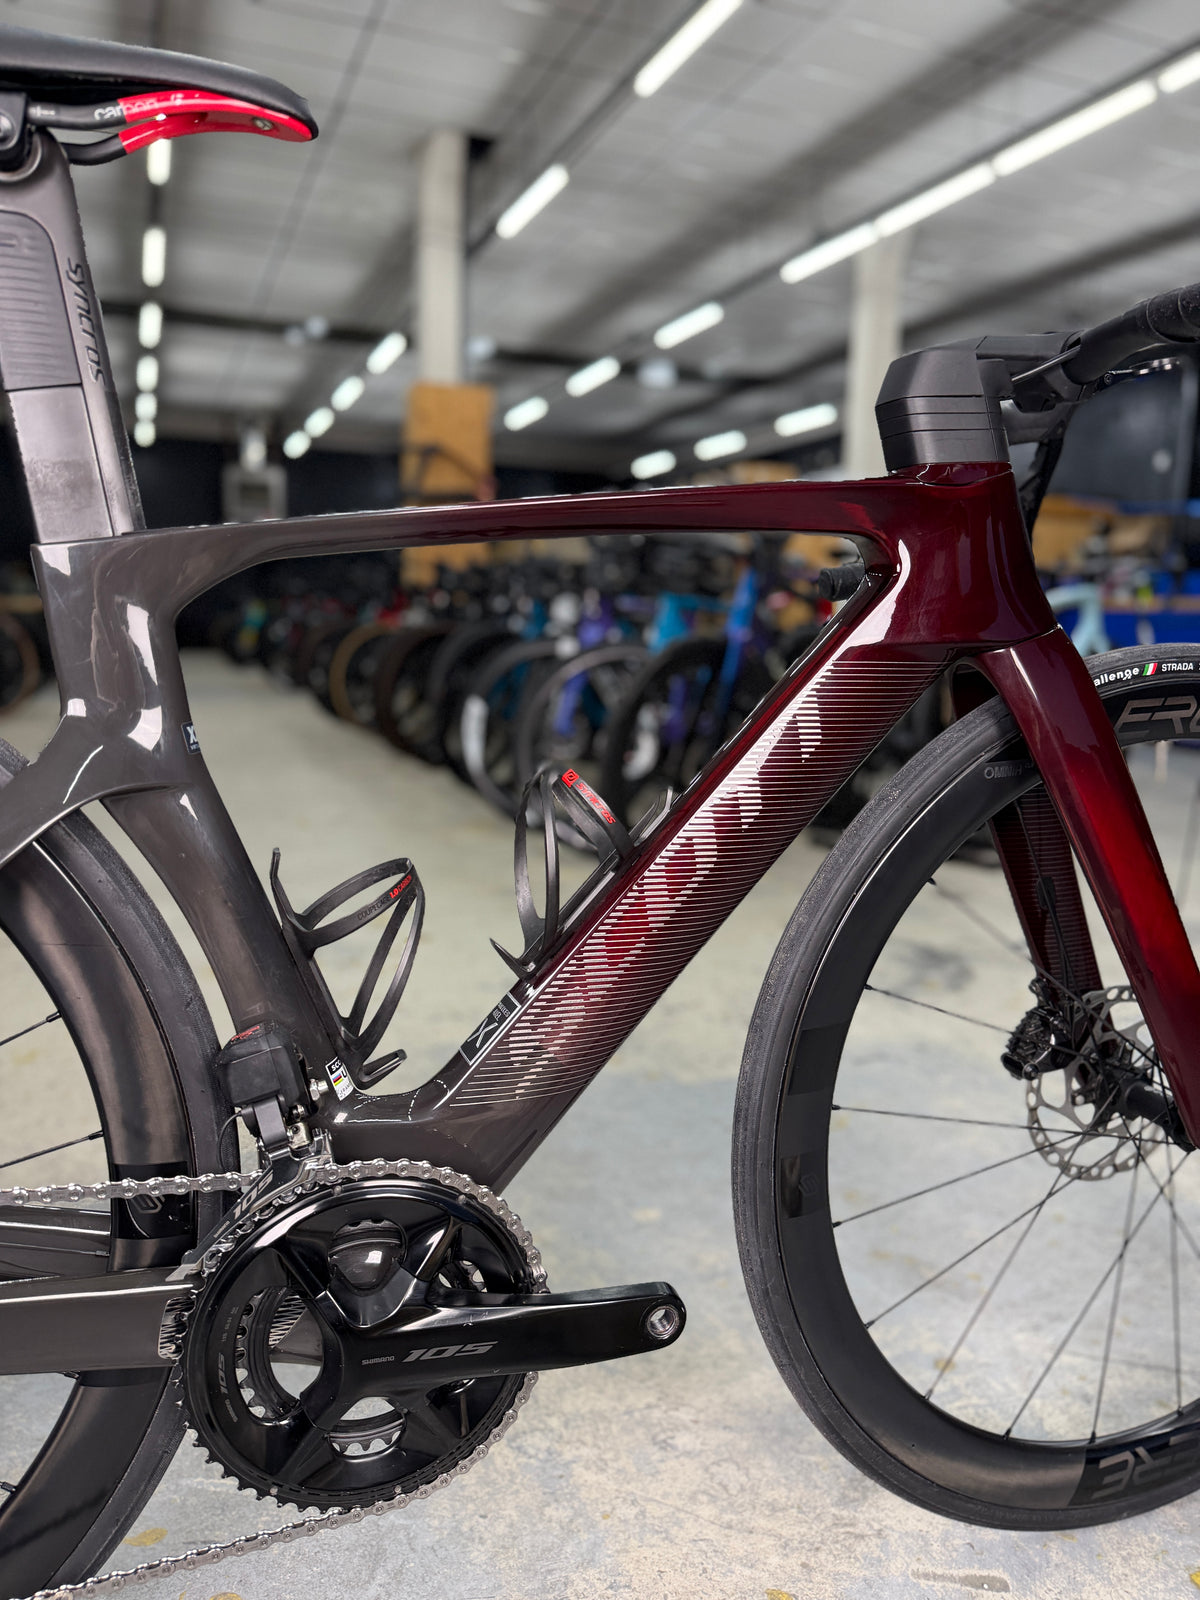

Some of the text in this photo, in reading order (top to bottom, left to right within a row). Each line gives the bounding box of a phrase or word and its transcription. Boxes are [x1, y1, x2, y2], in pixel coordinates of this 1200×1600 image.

[1093, 662, 1194, 687] allenge STRADA
[233, 1169, 274, 1220] 105
[361, 1340, 499, 1366] SHIMANO 105
